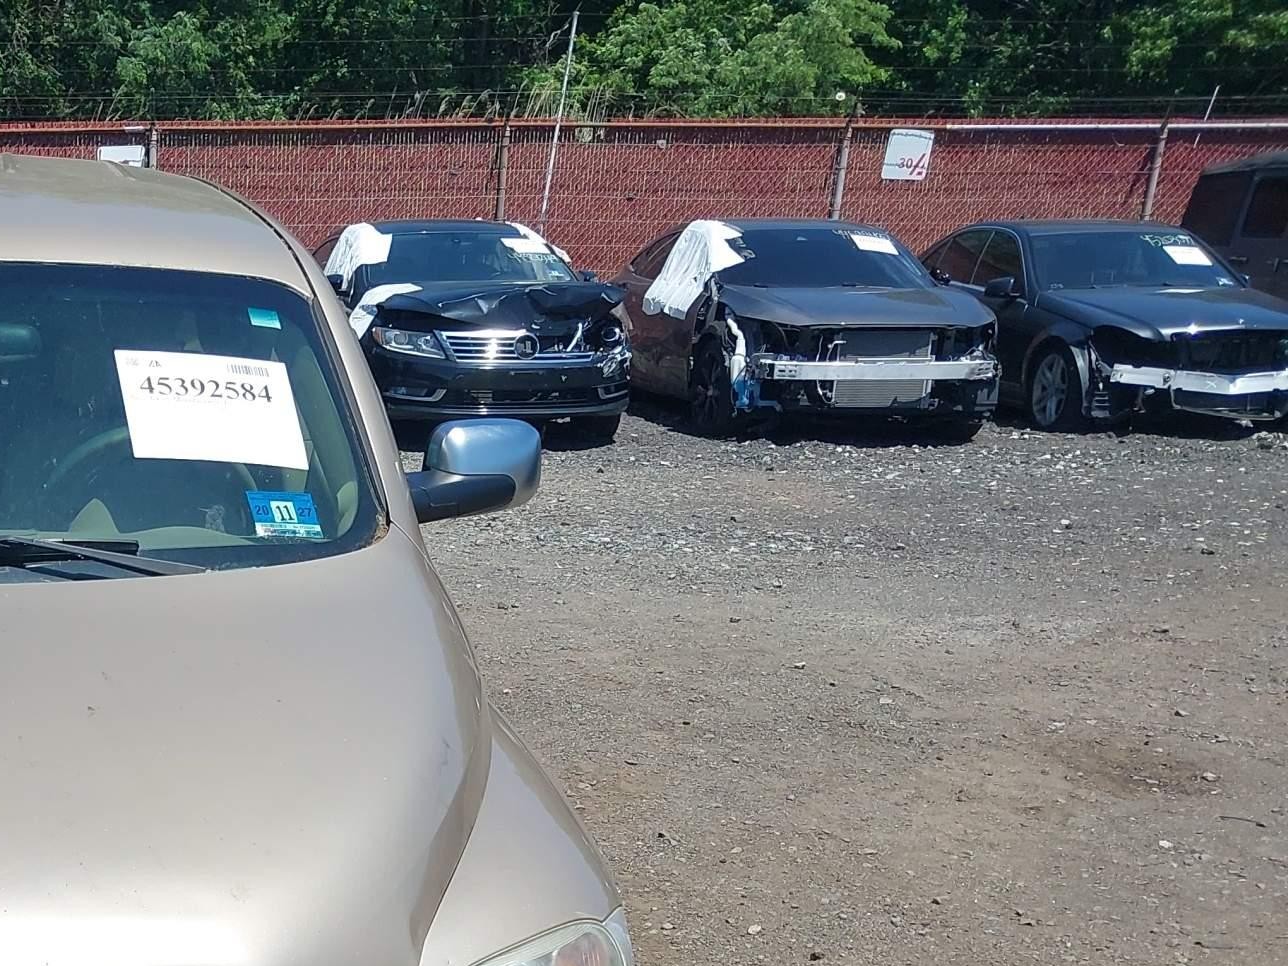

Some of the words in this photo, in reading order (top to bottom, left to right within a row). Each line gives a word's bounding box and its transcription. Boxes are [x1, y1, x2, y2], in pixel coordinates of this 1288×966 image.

[139, 375, 273, 403] 45392584
[255, 504, 270, 516] 20
[276, 504, 295, 521] 11
[297, 507, 312, 518] 27
